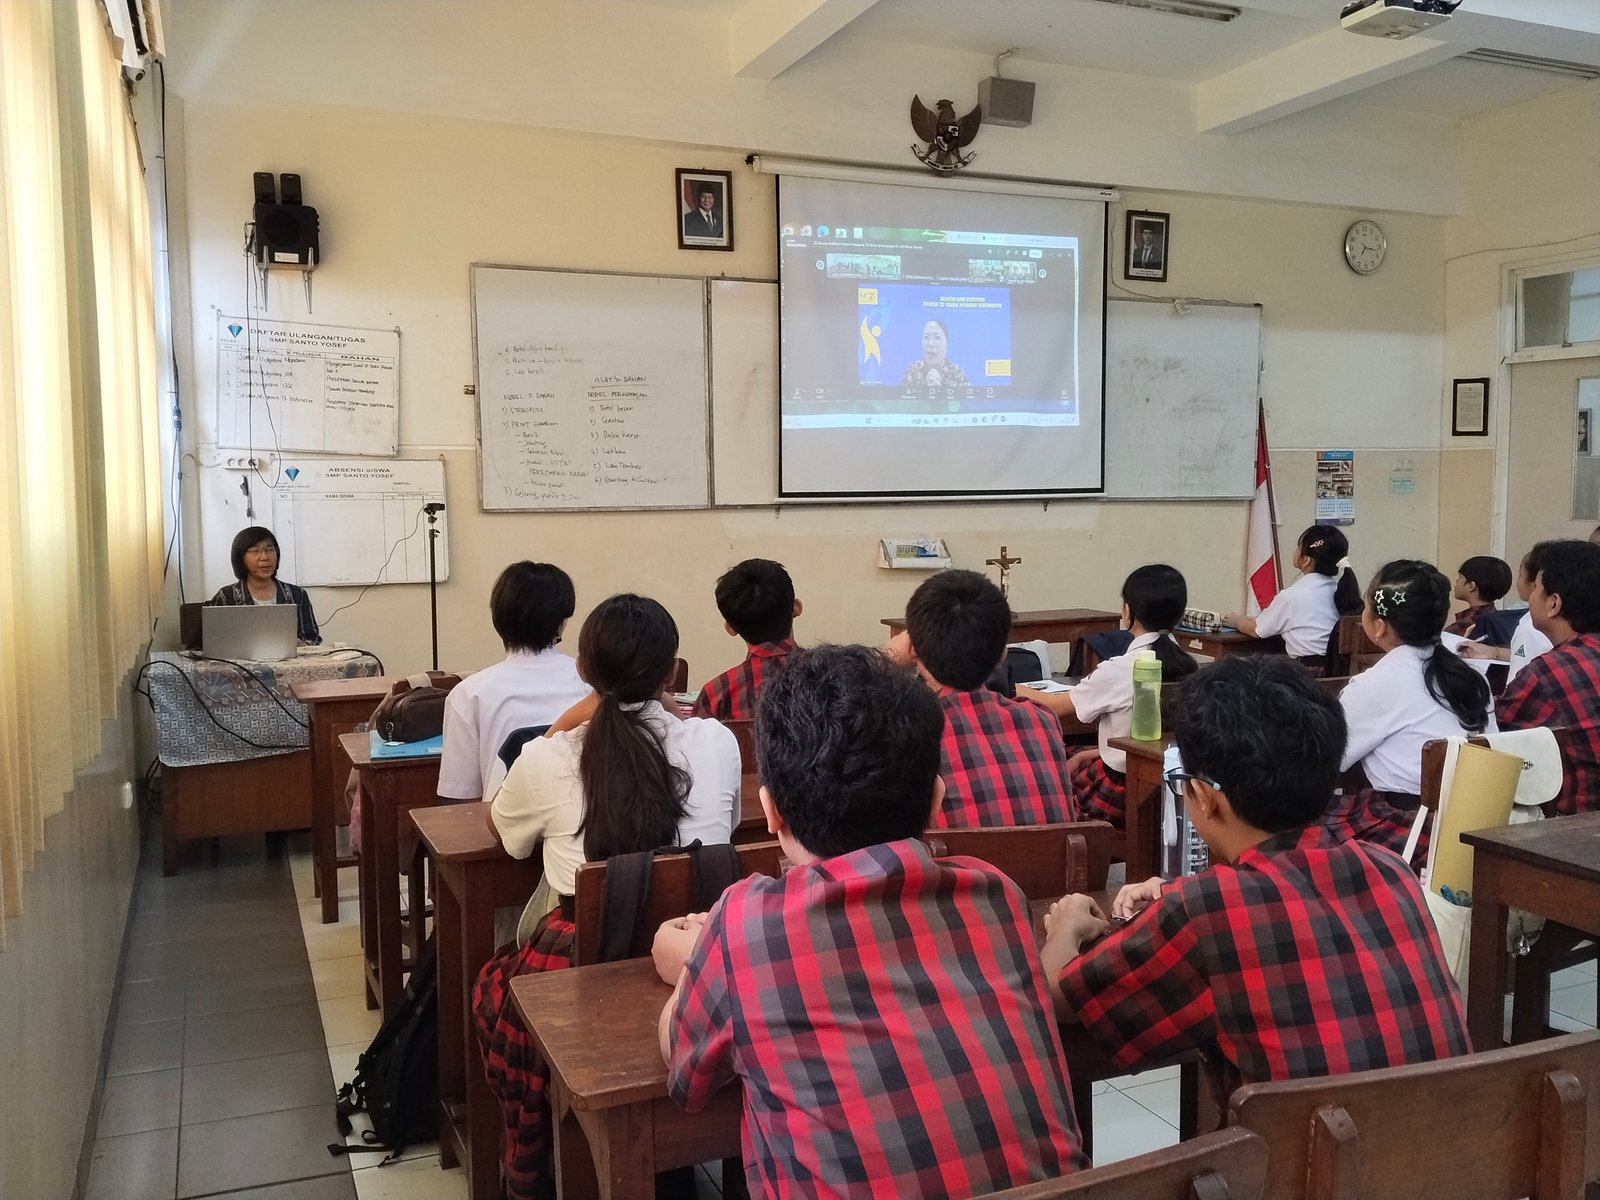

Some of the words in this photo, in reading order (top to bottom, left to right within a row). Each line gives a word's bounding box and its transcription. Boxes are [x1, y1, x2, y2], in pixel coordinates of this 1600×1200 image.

[250, 328, 287, 337] DAFTAR
[288, 332, 366, 344] ULANGAN/TUGAS
[289, 338, 318, 346] SANTO
[320, 341, 348, 349] YOSEF
[511, 420, 531, 428] PRINT
